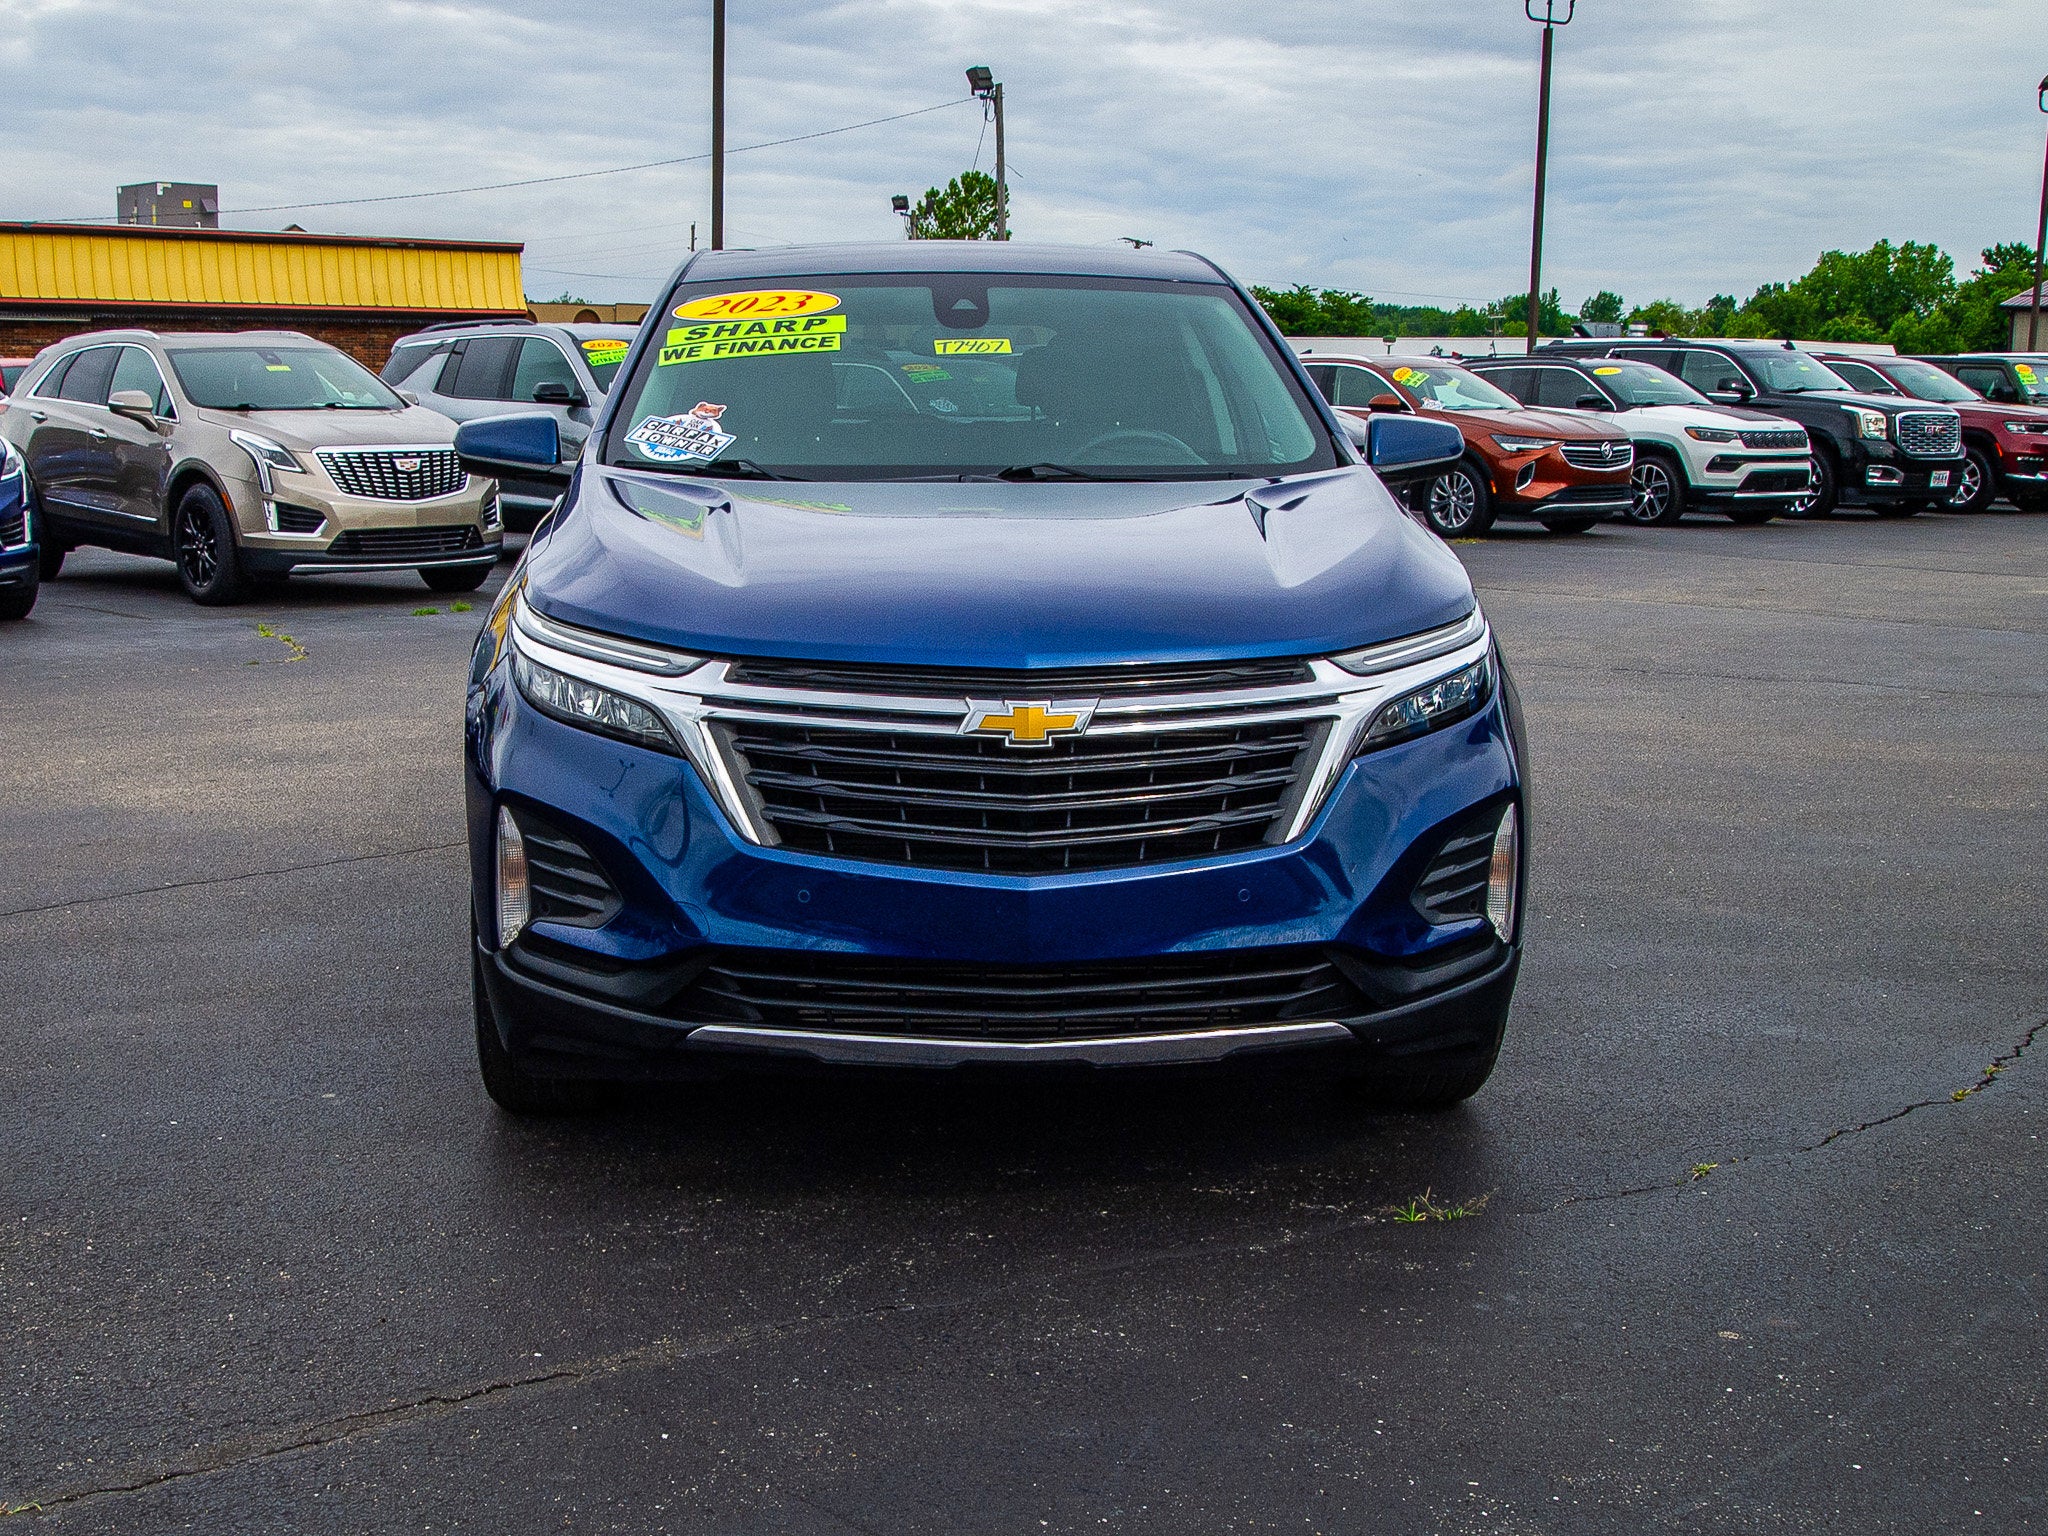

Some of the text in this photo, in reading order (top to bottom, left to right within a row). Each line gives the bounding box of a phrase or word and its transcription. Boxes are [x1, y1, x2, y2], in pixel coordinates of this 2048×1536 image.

[699, 294, 813, 317] 2023
[684, 318, 828, 341] SHARP
[663, 336, 836, 361] WE FINANCE
[637, 431, 645, 440] 1
[647, 432, 717, 455] OWNER
[644, 420, 723, 447] CARFAX
